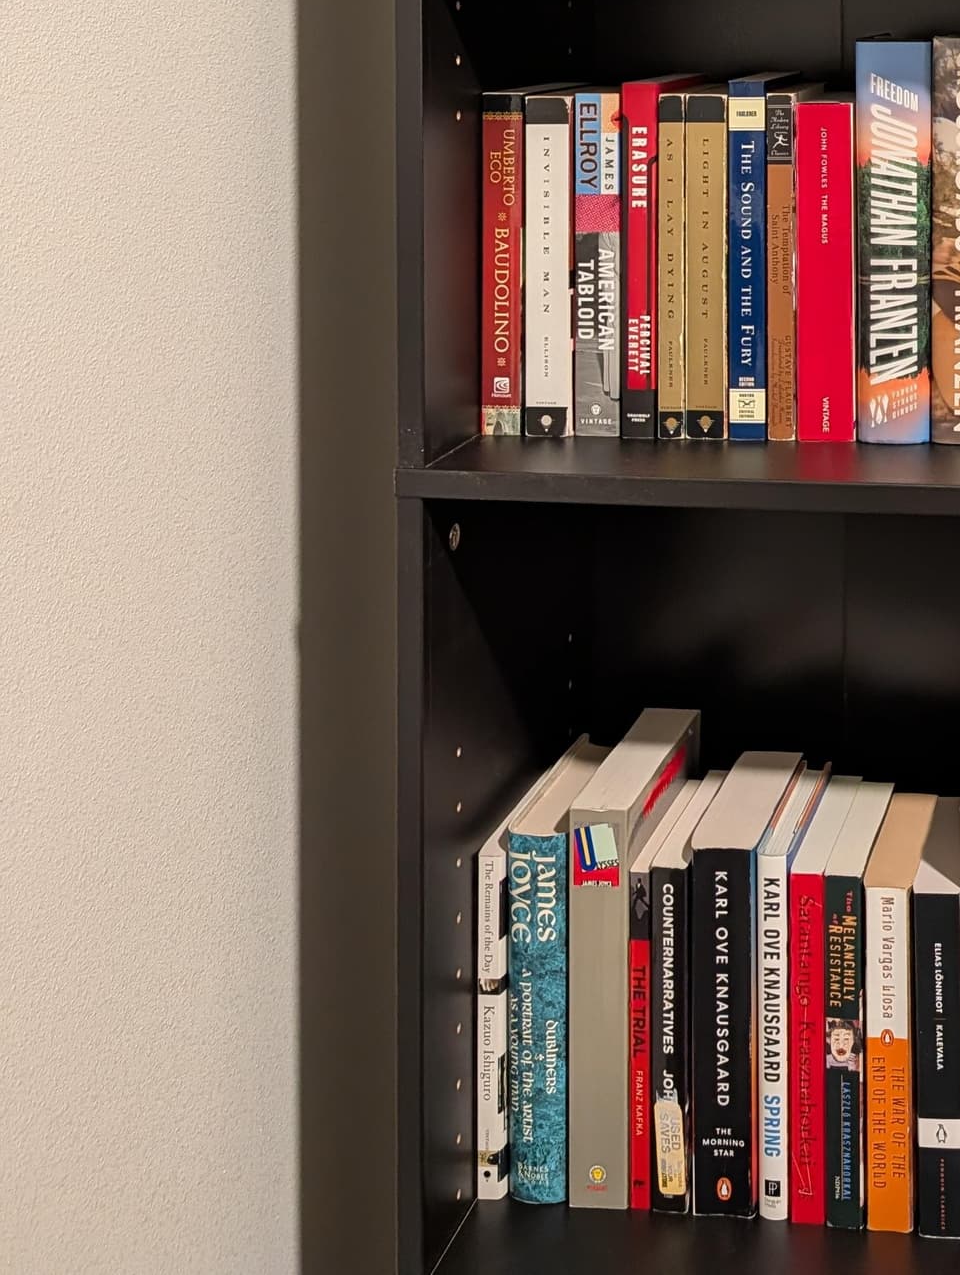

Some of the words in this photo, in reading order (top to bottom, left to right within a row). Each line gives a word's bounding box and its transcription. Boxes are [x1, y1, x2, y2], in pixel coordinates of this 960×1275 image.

[870, 73, 919, 113] FREEDOM
[489, 151, 502, 184] ECO
[502, 128, 516, 207] UMBERTO
[579, 102, 598, 189] ELLROY
[605, 137, 614, 191] JAMES
[631, 125, 647, 209] ERASURE
[740, 141, 755, 175] THE
[820, 154, 828, 189] FOWLES
[870, 102, 918, 248] JONATHAN
[740, 182, 755, 239] SOUND
[741, 244, 752, 279] AND
[493, 228, 511, 353] BAUDOLINO
[578, 260, 594, 340] TABLOID
[598, 248, 614, 351] AMERICAN
[741, 282, 752, 317] THE
[740, 324, 755, 366] FURY
[869, 258, 919, 386] FRANZEN
[509, 851, 531, 943] Joyce
[532, 850, 556, 942] James
[714, 870, 728, 919] KARL
[763, 877, 781, 922] KARL
[662, 883, 674, 1055] COUNTERNARRATIVES
[715, 927, 729, 965] OVE
[763, 928, 781, 961] OVE
[631, 965, 647, 993] THE
[483, 1005, 496, 1045] Kazuo
[631, 999, 647, 1059] TRIAL
[715, 973, 730, 1108] KNAUSGAARD
[763, 965, 781, 1084] KNAUSGAARD
[479, 1049, 493, 1102] Ishiguro
[763, 1095, 781, 1158] SPRING
